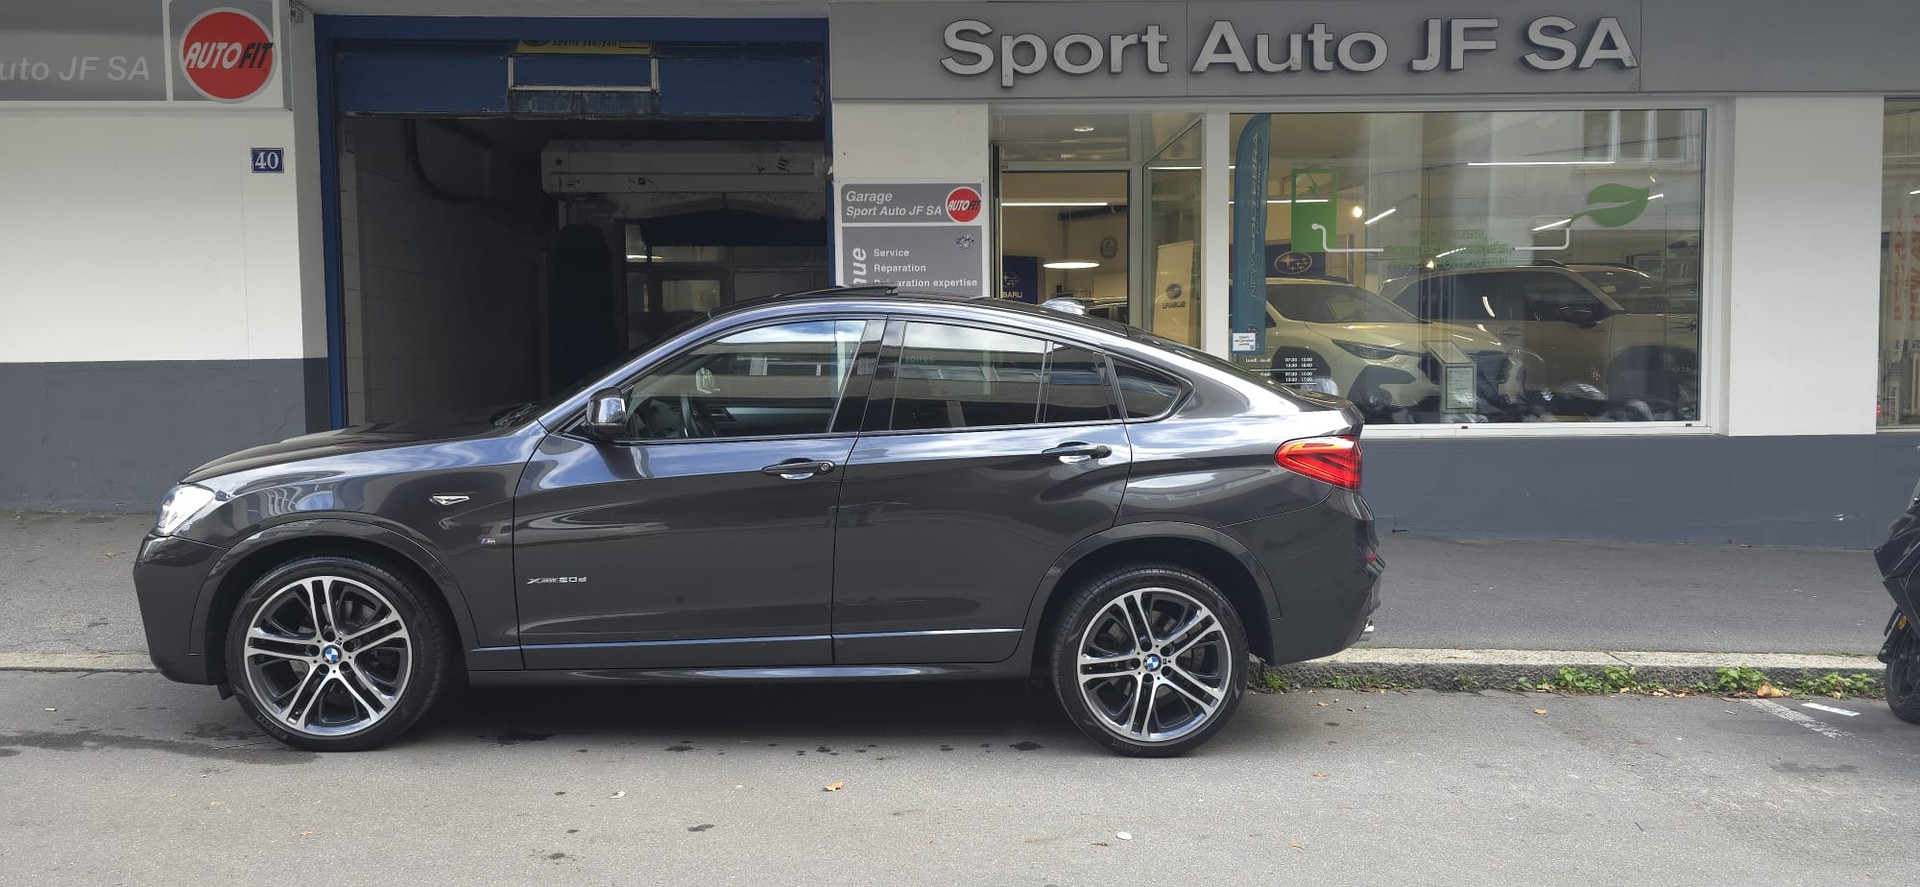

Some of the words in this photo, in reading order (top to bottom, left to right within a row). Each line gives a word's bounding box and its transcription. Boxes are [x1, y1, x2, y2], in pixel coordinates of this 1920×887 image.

[185, 42, 274, 69] AUTOFIT
[940, 19, 1169, 88] Sport
[1191, 20, 1389, 73] Auto
[1411, 18, 1500, 72] JF
[1522, 15, 1640, 71] SA
[0, 60, 49, 81] uto
[59, 56, 99, 81] JF
[107, 56, 150, 81] SA
[255, 152, 279, 170] 40
[846, 191, 893, 204] Garage
[846, 206, 877, 219] Sport
[879, 206, 906, 216] Auto
[909, 206, 923, 216] JF
[926, 205, 942, 216] SA
[873, 249, 910, 257] Service
[873, 263, 927, 273] Réparation
[933, 279, 978, 288] expertise
[1001, 291, 1023, 299] BARU
